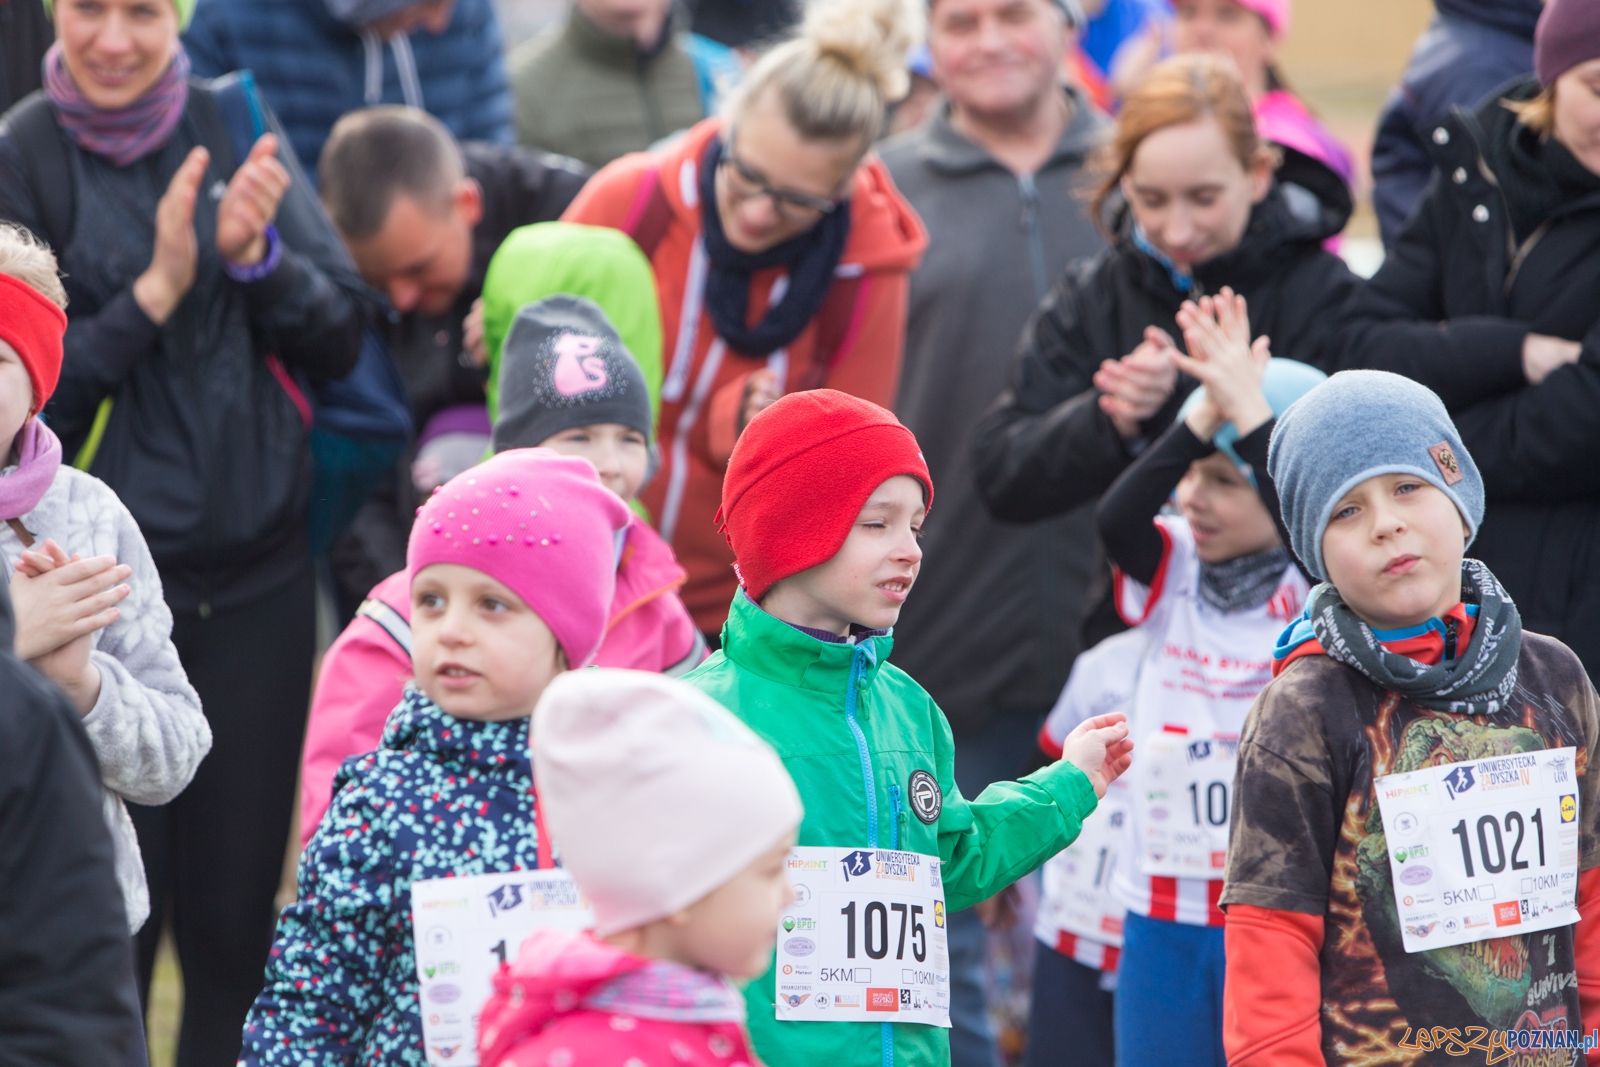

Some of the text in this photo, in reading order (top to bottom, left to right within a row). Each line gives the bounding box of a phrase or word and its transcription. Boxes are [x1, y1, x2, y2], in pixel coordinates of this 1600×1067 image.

[1477, 755, 1537, 774] UNIWERSYTECKA
[1480, 771, 1520, 787] ZADYSZKA
[1452, 807, 1546, 878] 1021
[875, 850, 920, 867] UNIWERSYTECKA
[875, 862, 908, 877] ZADYSZKA
[1533, 873, 1559, 891] 10KM
[1443, 887, 1478, 906] 5KM
[841, 901, 927, 963] 1075
[820, 967, 853, 982] 5KM
[914, 970, 935, 986] 10KM
